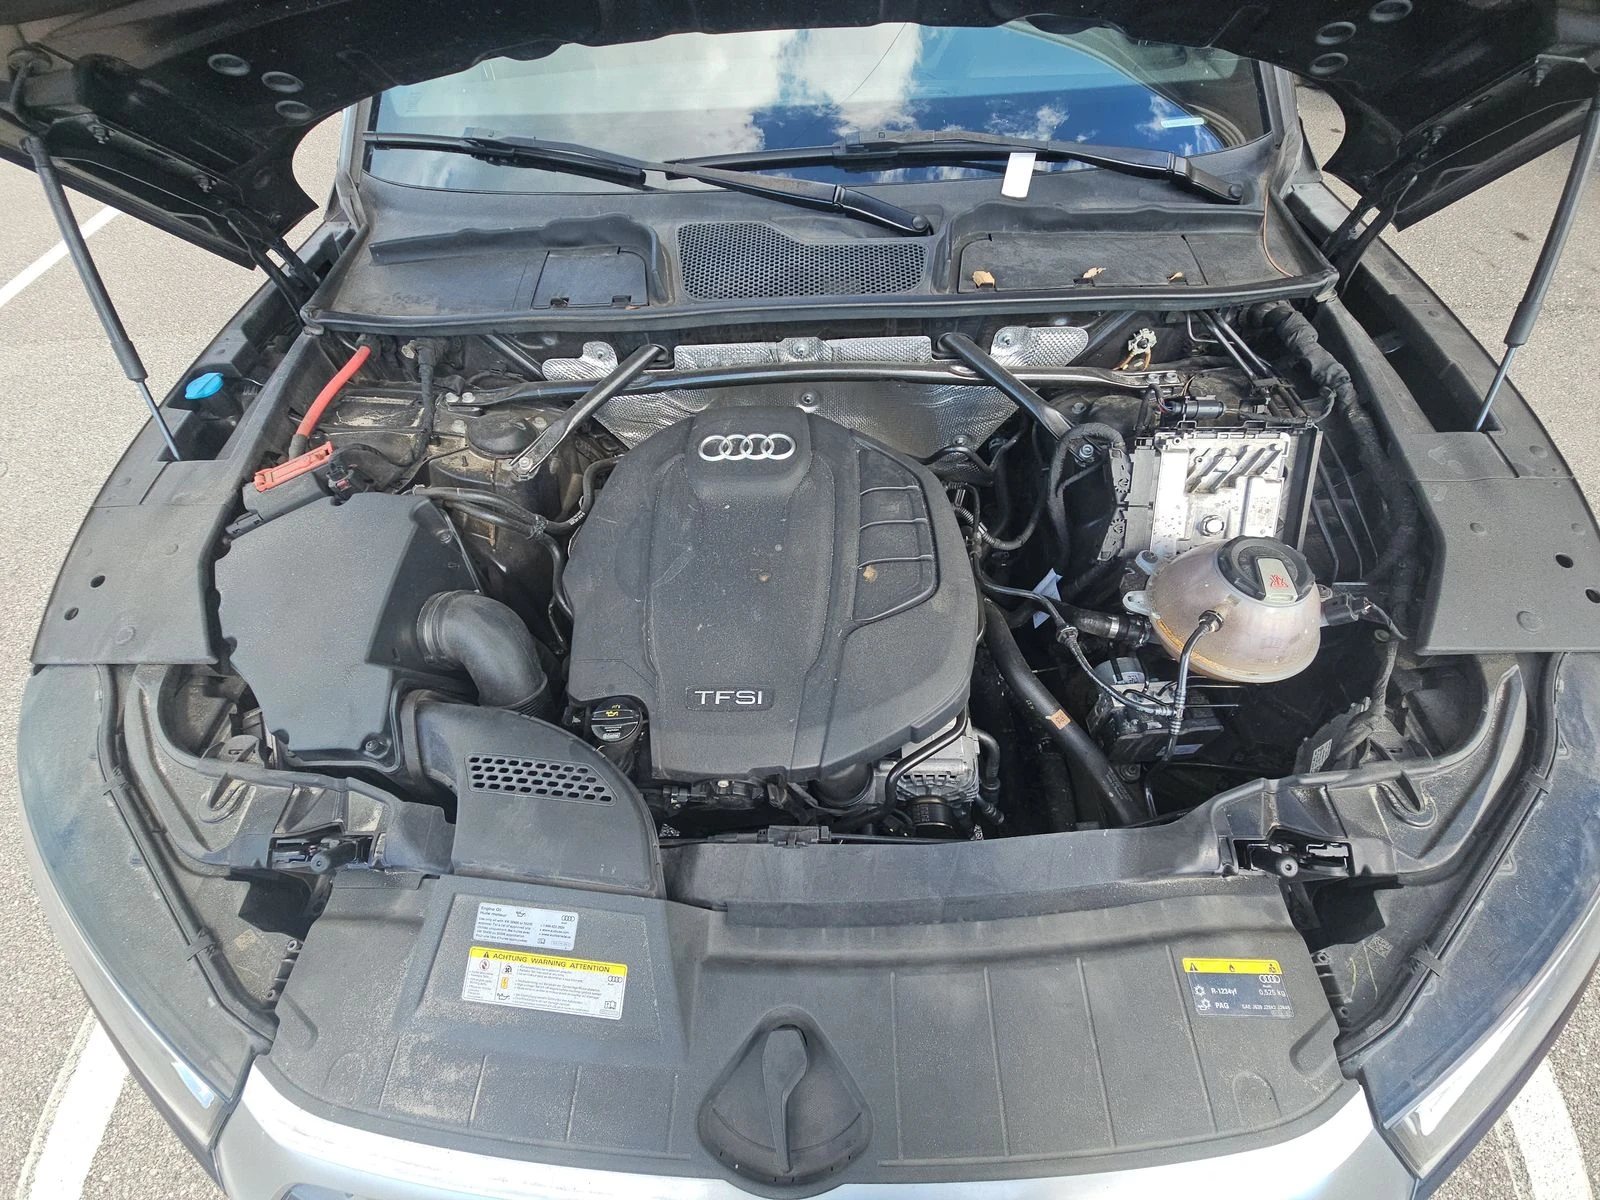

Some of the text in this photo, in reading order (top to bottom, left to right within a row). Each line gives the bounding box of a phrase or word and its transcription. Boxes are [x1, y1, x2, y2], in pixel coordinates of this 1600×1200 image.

[694, 690, 763, 705] TFSI
[492, 952, 611, 973] ACHTUNG WARNING ATTENTION
[1277, 989, 1286, 998] kg
[1214, 1001, 1230, 1009] PAG
